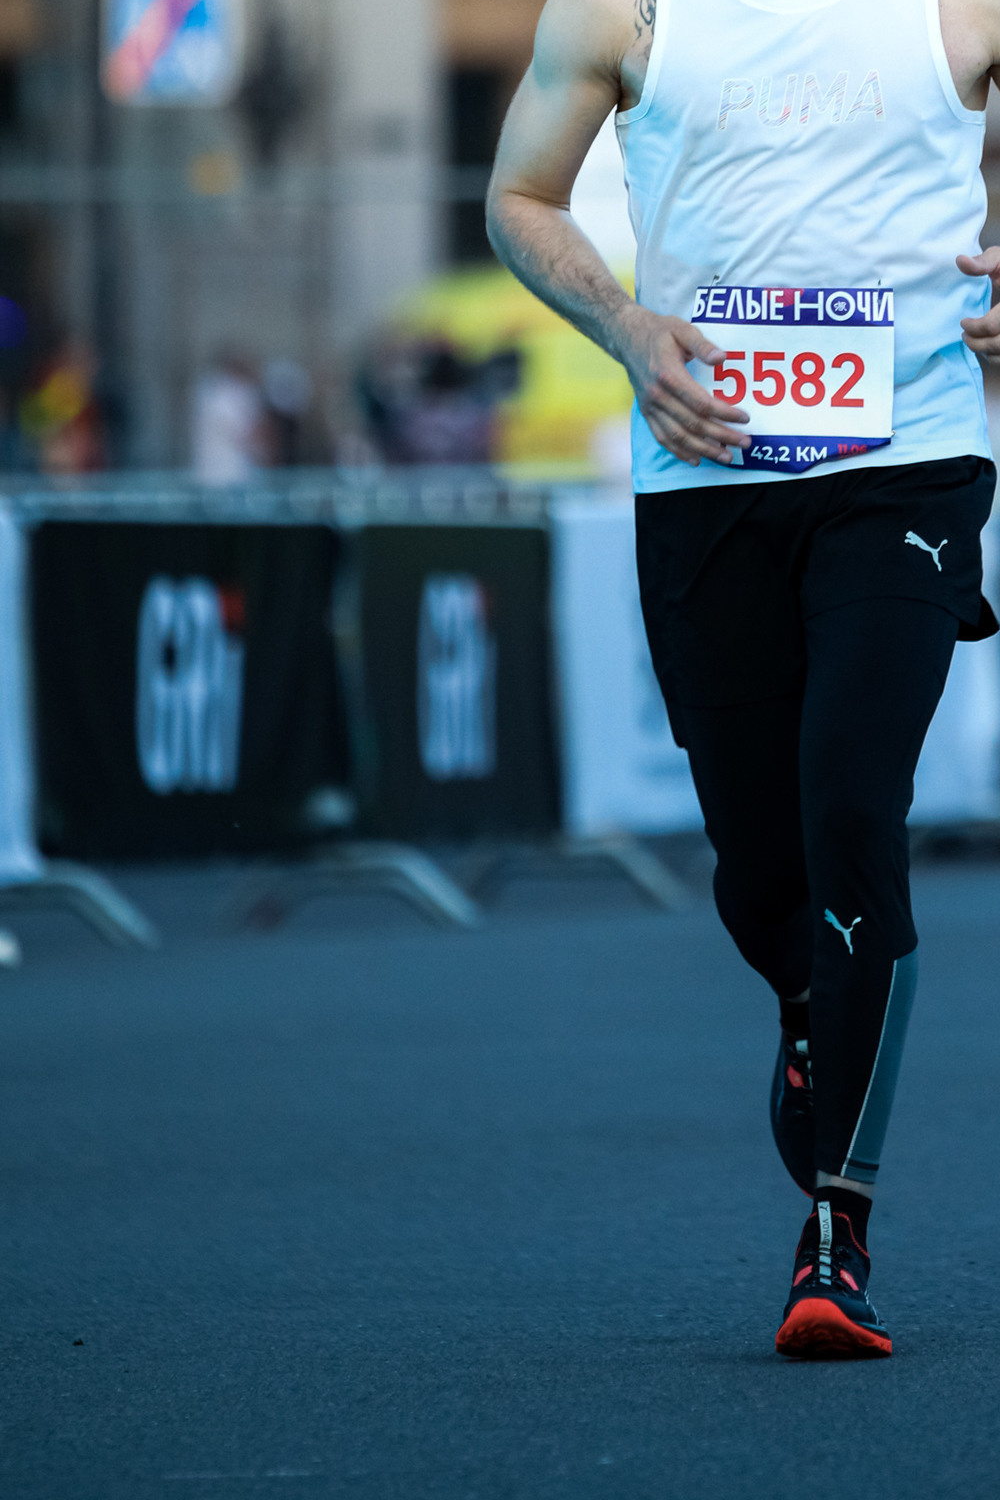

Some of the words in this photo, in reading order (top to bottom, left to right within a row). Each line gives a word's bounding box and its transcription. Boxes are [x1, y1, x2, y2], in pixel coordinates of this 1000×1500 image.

[715, 69, 886, 131] PUMA
[691, 288, 784, 321] БЕЛЫЕ
[794, 290, 894, 322] НОЧИ
[713, 350, 865, 407] 5582
[751, 446, 790, 464] 42,2
[796, 446, 828, 462] КМ
